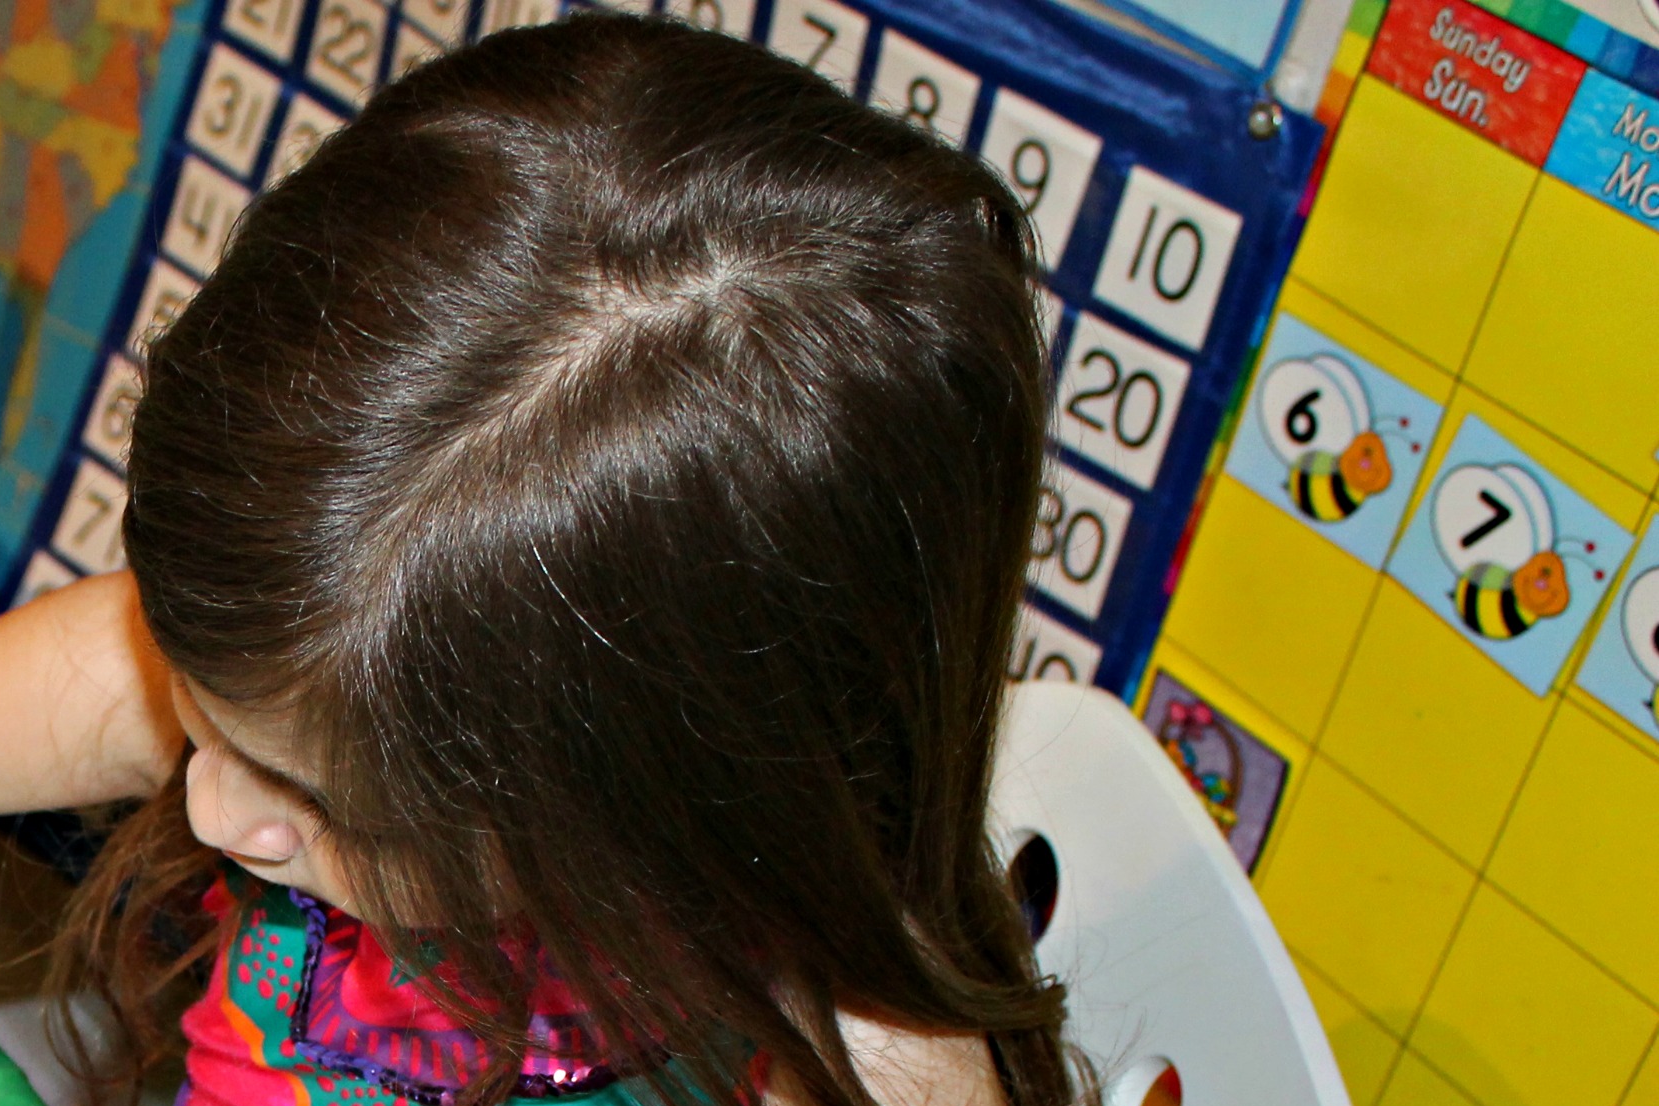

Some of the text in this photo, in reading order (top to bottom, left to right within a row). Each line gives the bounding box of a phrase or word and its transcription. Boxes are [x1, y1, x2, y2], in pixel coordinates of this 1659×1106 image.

[318, 4, 374, 88] 22
[1430, 8, 1532, 95] Sunday
[203, 74, 262, 151] 31
[1423, 60, 1491, 127] Sun.
[1011, 139, 1050, 215] 9
[1125, 204, 1203, 302] 10
[1065, 348, 1163, 450] 20
[1285, 390, 1321, 444] 6
[1459, 488, 1512, 549] 7
